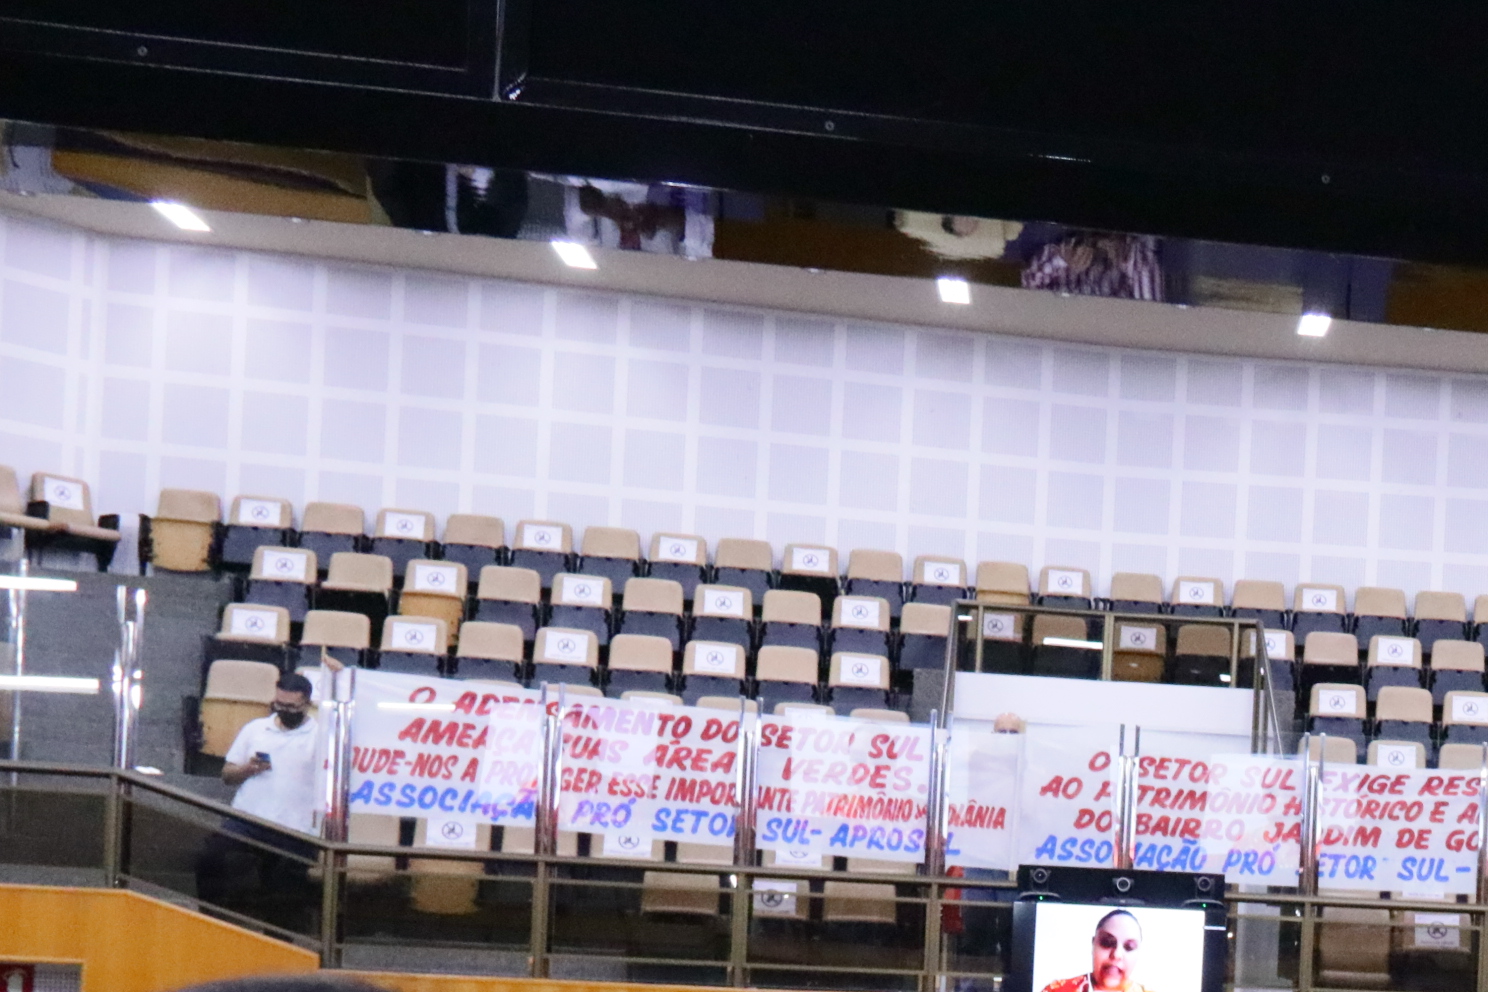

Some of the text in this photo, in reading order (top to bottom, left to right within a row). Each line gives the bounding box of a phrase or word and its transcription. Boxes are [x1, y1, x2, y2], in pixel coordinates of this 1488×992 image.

[700, 717, 740, 743] DO
[760, 723, 924, 761] SETOR SUL
[398, 717, 537, 757] AMEAÇA
[781, 756, 928, 794] VERDES.
[1088, 751, 1297, 791] O SETOR SUL
[460, 757, 480, 783] A
[607, 771, 661, 799] ESSE
[800, 790, 914, 823] PATRIMÔNIO
[1039, 776, 1084, 800] AO
[1093, 780, 1277, 816] PTRIMÔNIO
[1428, 801, 1450, 824] E
[1321, 770, 1411, 796] EXIGE
[571, 797, 637, 828] PRÓ
[829, 823, 961, 857] APROSL
[1073, 808, 1113, 833] DO
[1135, 813, 1246, 841] BAIRRO
[1263, 821, 1382, 848] JADIM
[1395, 827, 1433, 850] DE
[1222, 843, 1282, 876] PRÓ
